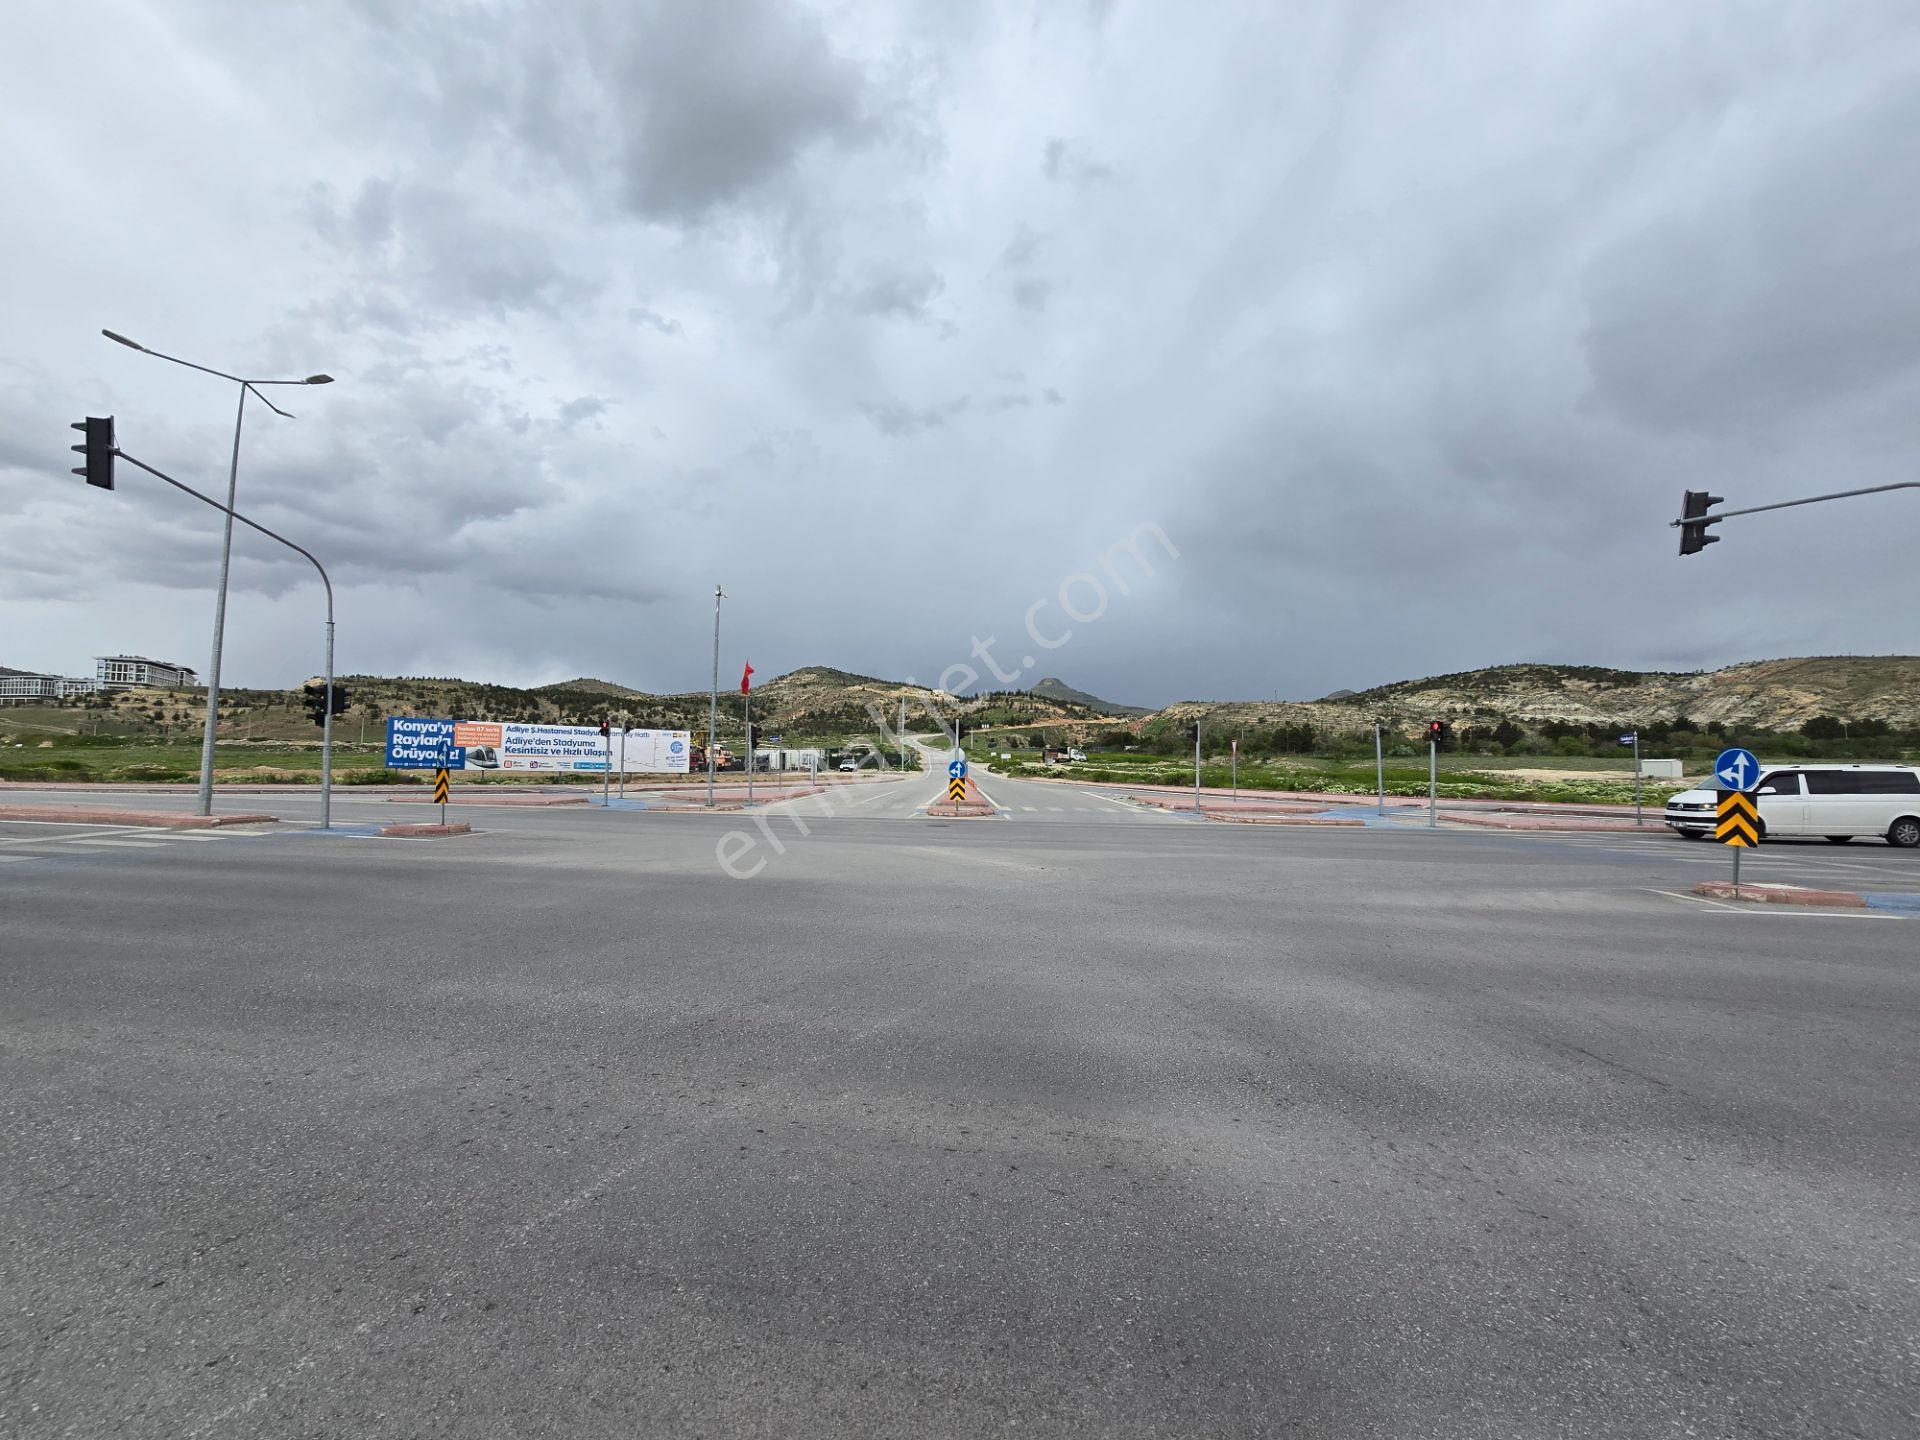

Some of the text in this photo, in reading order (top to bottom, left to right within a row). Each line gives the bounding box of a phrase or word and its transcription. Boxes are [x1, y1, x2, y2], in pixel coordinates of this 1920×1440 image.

[393, 720, 453, 734] Konya'yı
[506, 726, 529, 734] Adliye
[505, 737, 596, 748] Adliye'den Stadyuma
[504, 745, 548, 755] Kesintisiz
[563, 748, 581, 756] Hızlı
